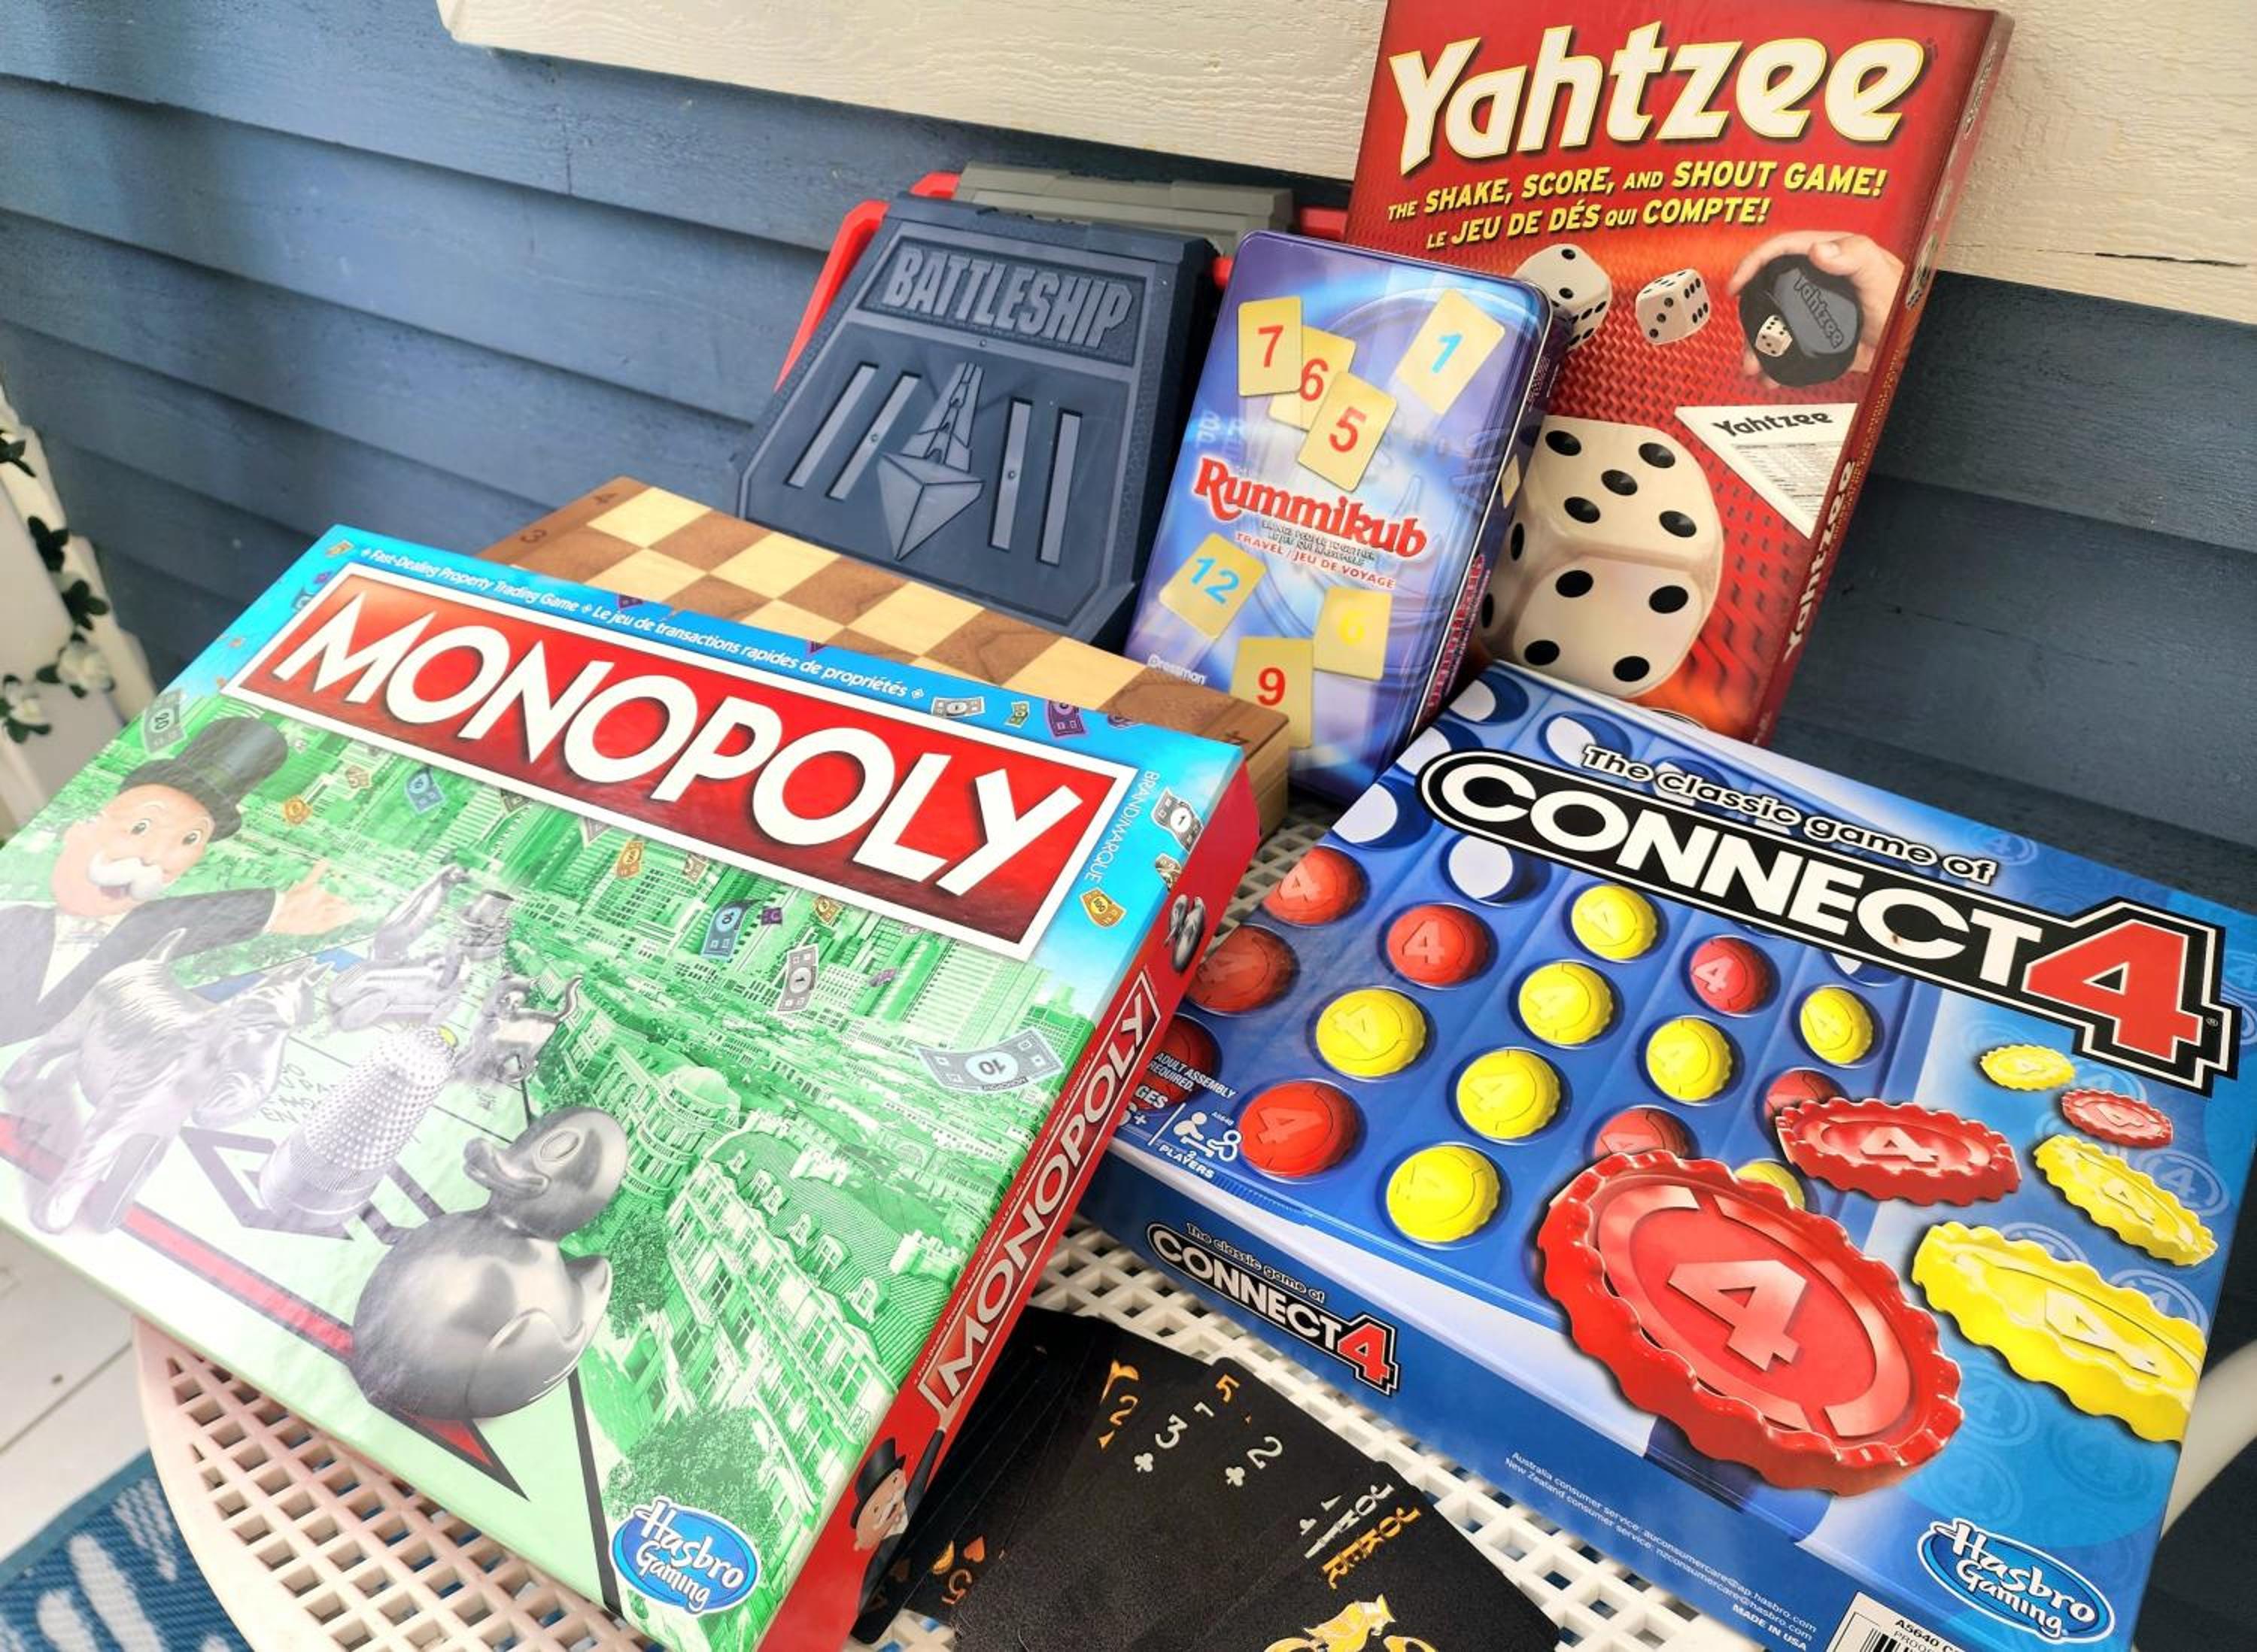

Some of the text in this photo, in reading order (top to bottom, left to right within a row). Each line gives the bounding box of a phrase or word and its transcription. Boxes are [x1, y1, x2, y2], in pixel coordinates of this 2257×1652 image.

[1388, 21, 1925, 176] Yahtzee
[1387, 162, 1887, 222] THE SHAKE, SCORE, AND SHOUT GAME!
[1426, 197, 1769, 250] LE JEU DE DÉS QUI COMPTE!
[882, 247, 1132, 348] BATTLESHIP
[1794, 275, 1845, 350] Yahtzee
[1258, 324, 1284, 368] 7
[1432, 332, 1463, 373] 1
[1299, 357, 1329, 402] 6
[1329, 407, 1367, 453] 5
[1712, 413, 1833, 436] Yahtzee
[1194, 457, 1427, 557] Rummikub
[1190, 557, 1241, 604] 12
[1236, 532, 1284, 556] TRAVEL
[1293, 551, 1317, 564] JEU
[1321, 558, 1338, 572] DE
[1342, 564, 1396, 589] VOYAGE
[1783, 451, 1857, 662] Yahtzee
[369, 550, 909, 698] Fast-Dealing Property Trading Game Le jeu de transactions rapides de propriétés
[1257, 667, 1286, 706] 9
[273, 591, 1083, 896] MONOPOLY
[1584, 746, 1998, 885] The classic game of
[1441, 763, 2203, 1063] CONNECT 4
[1135, 1086, 1168, 1108] GES
[1147, 1061, 1194, 1091] REQUIRED.
[1156, 1053, 1236, 1098] ADULT ASSEMBLY
[1159, 1144, 1215, 1179] PLAYERS
[937, 993, 1145, 1396] MONOPOLY
[1187, 1222, 1325, 1304] The classic game of
[1153, 1230, 1390, 1385] CONNECT 4
[1667, 1260, 1807, 1371] 4
[1156, 1414, 1189, 1449] 3
[1247, 1436, 1283, 1468] 2
[1505, 1459, 1526, 1473] New
[1526, 1470, 1566, 1499] Zealand
[1566, 1492, 1614, 1527] consumer
[1511, 1452, 1553, 1480] Australia
[1554, 1474, 1602, 1508] consumer
[634, 1500, 745, 1590] Hasbro
[636, 1540, 710, 1608] Gaming
[1322, 1507, 1420, 1590] JOKER
[1934, 1521, 2096, 1622] Hasbro
[1733, 1604, 1808, 1651] MADE IN USA
[1957, 1559, 2062, 1638] Gaming
[1895, 1620, 1940, 1647] A5640
